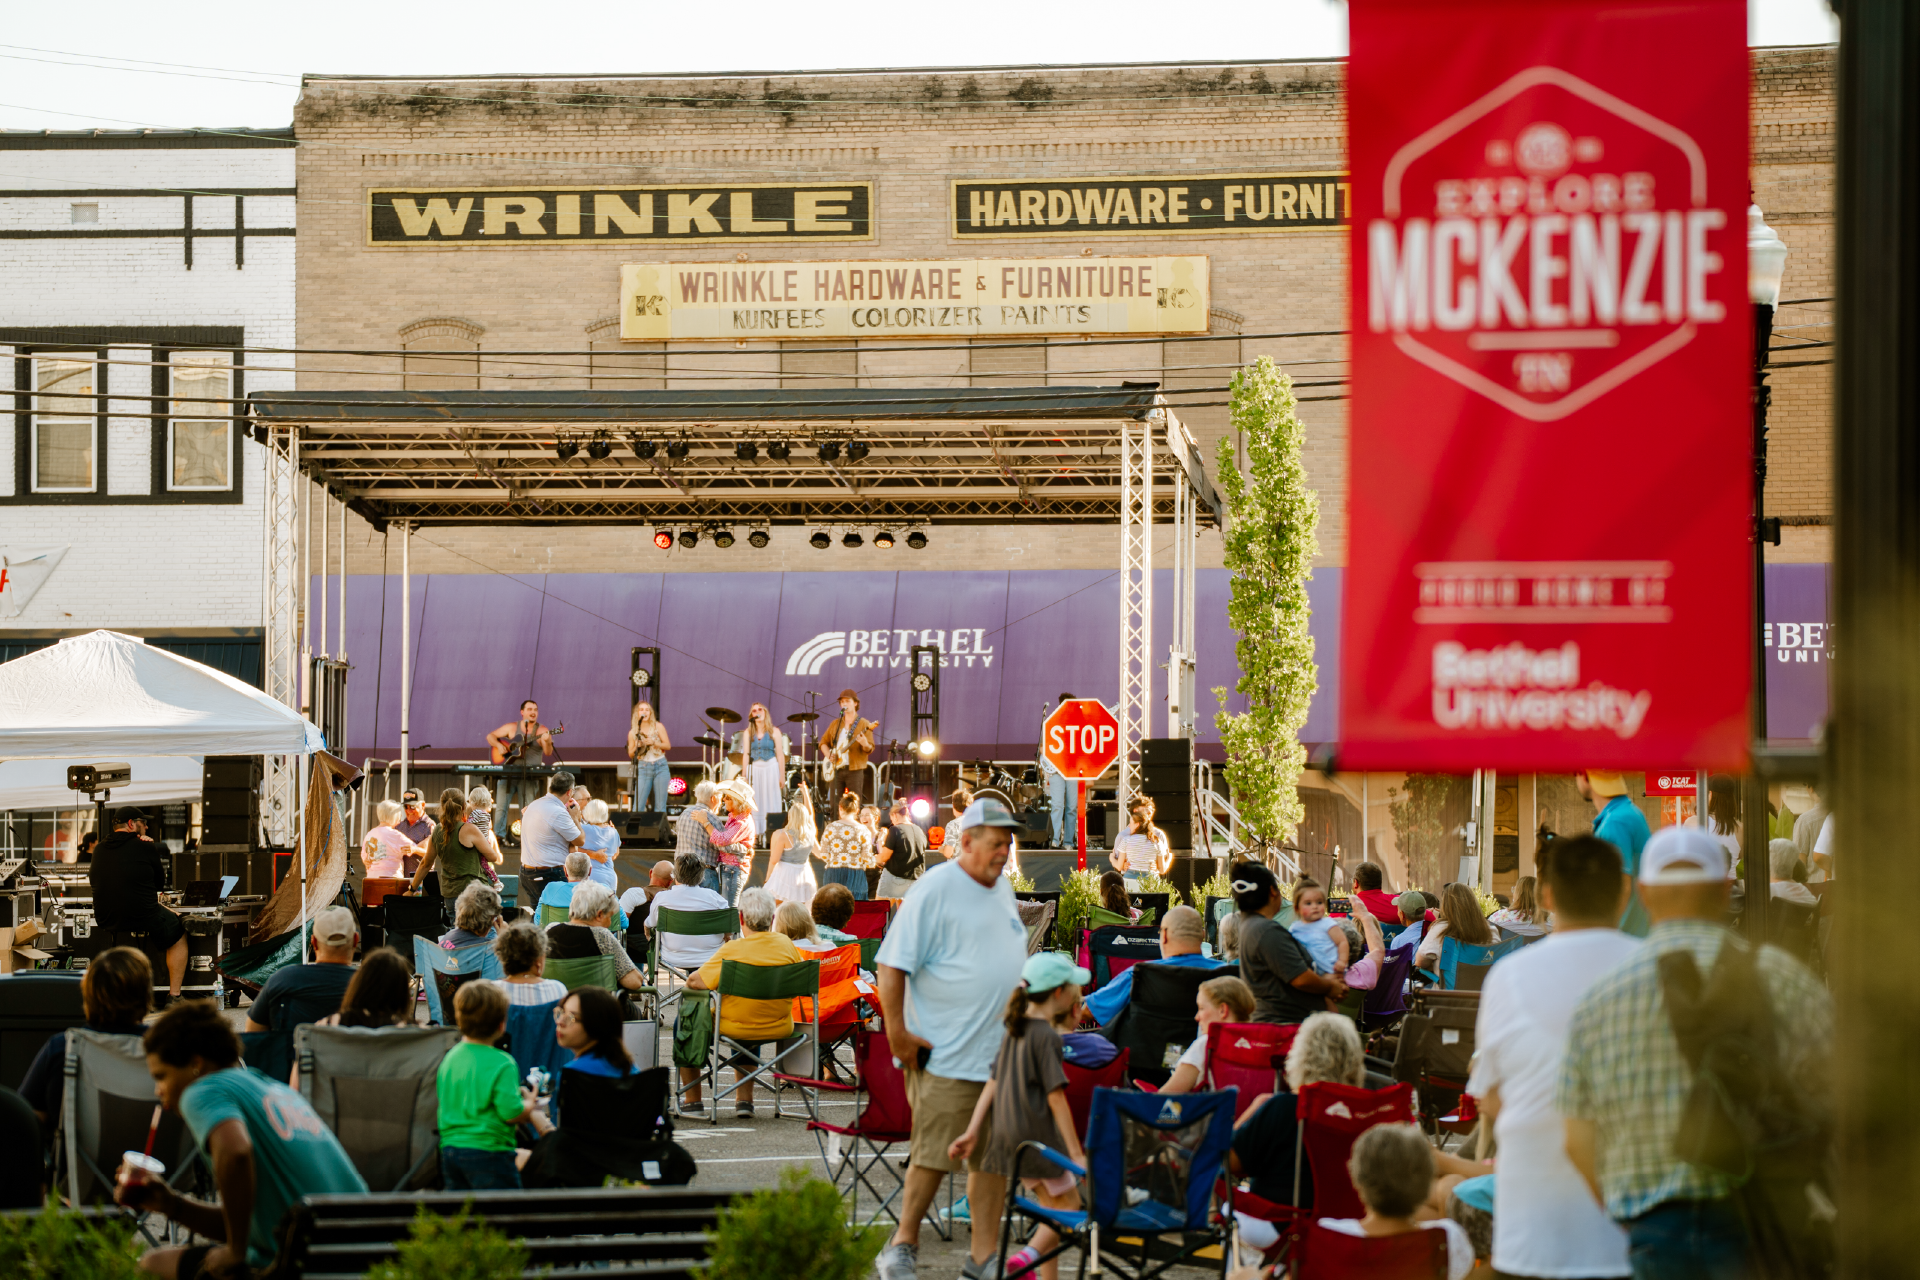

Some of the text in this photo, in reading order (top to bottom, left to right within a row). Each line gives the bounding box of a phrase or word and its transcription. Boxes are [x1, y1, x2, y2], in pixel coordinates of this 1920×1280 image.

[391, 190, 853, 236] WRINKLE
[969, 187, 1189, 227] HARDWARE
[1434, 172, 1656, 218] EXPLORE
[679, 265, 1153, 303] WRINKLE HARDWARE & FURNITURE
[1367, 208, 1727, 334] MCKENZIE
[733, 304, 1092, 330] KURFEES COLORIZER PAINTS
[847, 628, 993, 655] BETHEL
[1433, 640, 1580, 690] Bethel
[1432, 680, 1652, 740] University
[1048, 725, 1115, 755] STOP
[1671, 776, 1691, 785] TCAT
